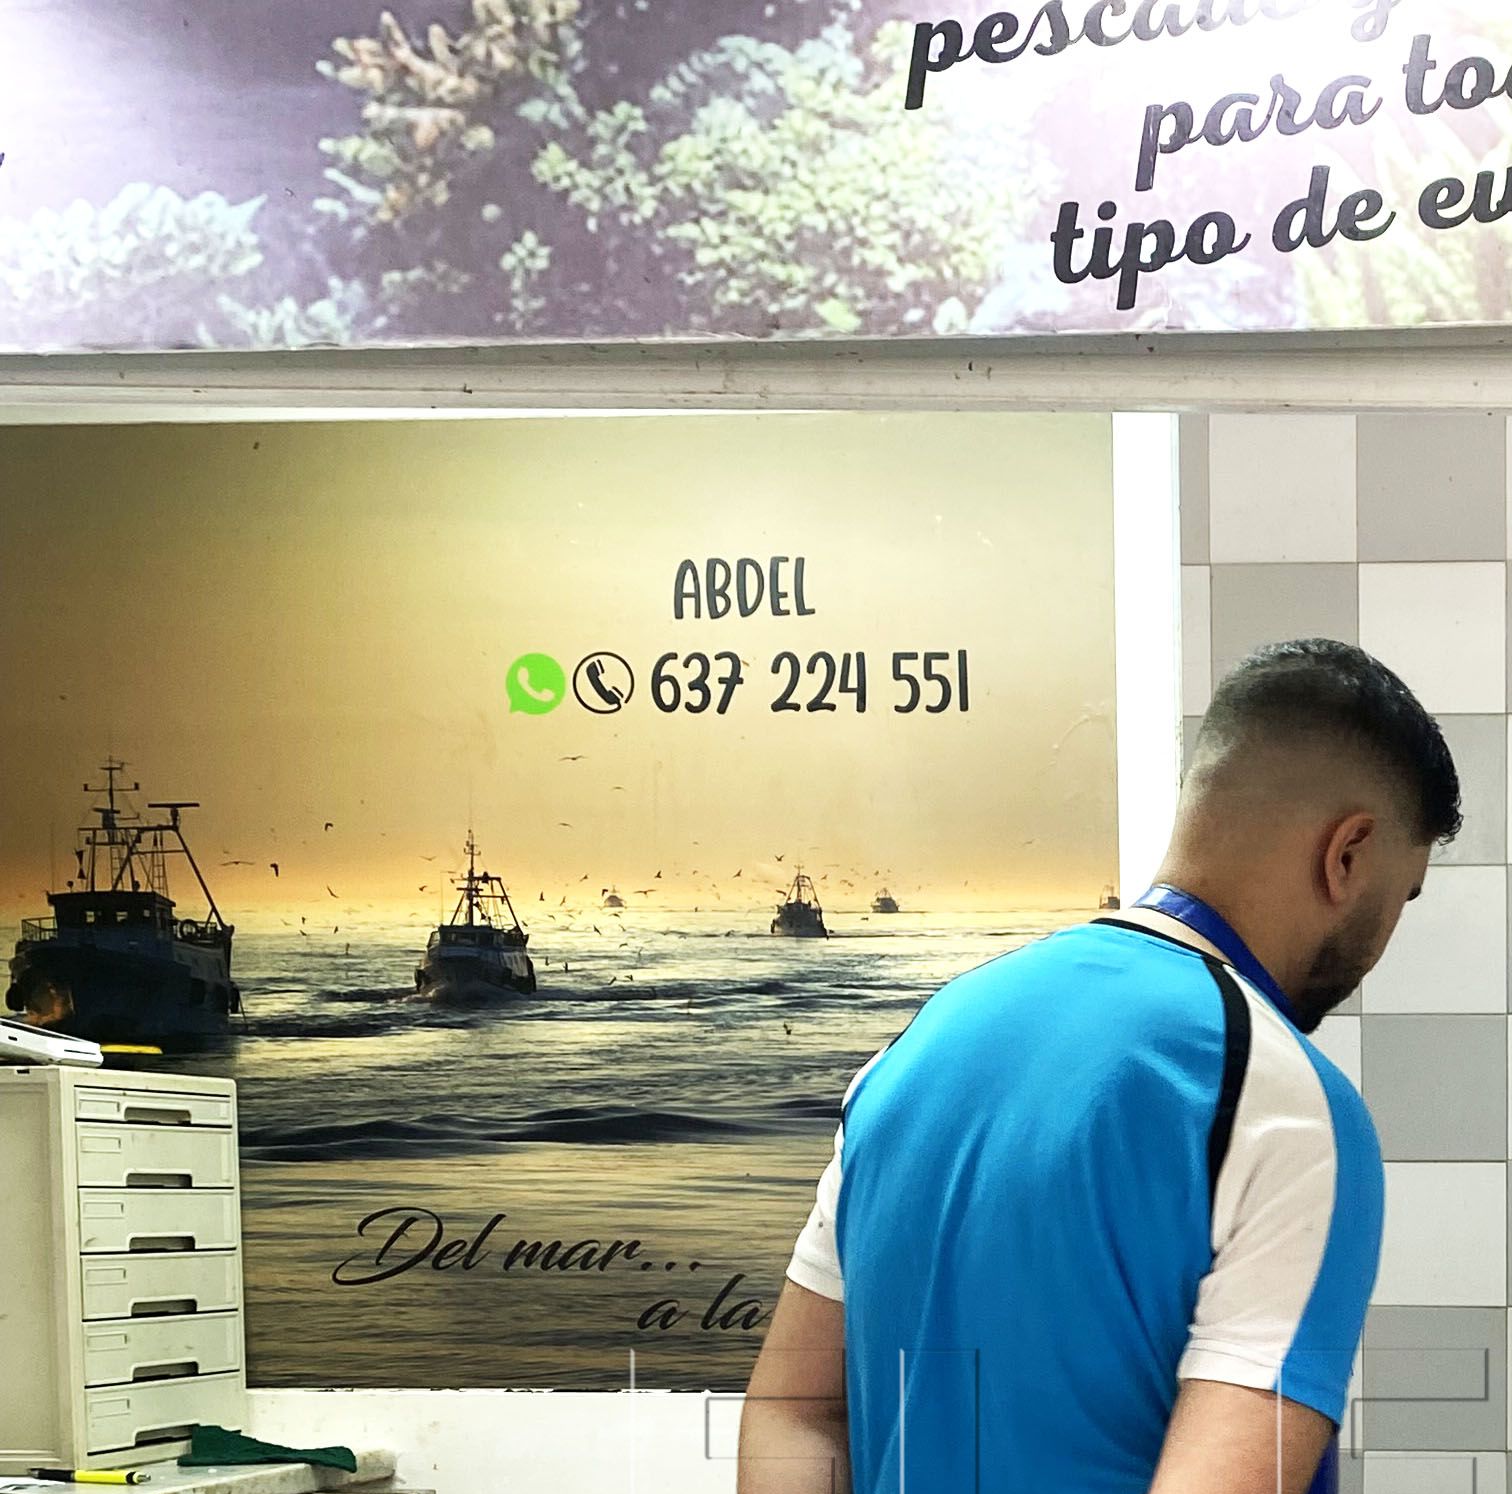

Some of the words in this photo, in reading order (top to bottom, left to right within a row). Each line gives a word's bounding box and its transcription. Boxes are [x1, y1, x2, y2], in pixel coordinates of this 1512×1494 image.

[905, 0, 1302, 109] pesca
[1135, 73, 1383, 192] para
[1050, 200, 1252, 311] tipo
[1271, 165, 1396, 253] de
[673, 556, 816, 620] ABDEL
[651, 651, 744, 715] 637
[771, 650, 867, 713] 224
[892, 649, 969, 713] 551
[331, 1206, 507, 1286] Del
[503, 1238, 703, 1272] mar...
[637, 1299, 691, 1330] a
[700, 1273, 774, 1330] la
